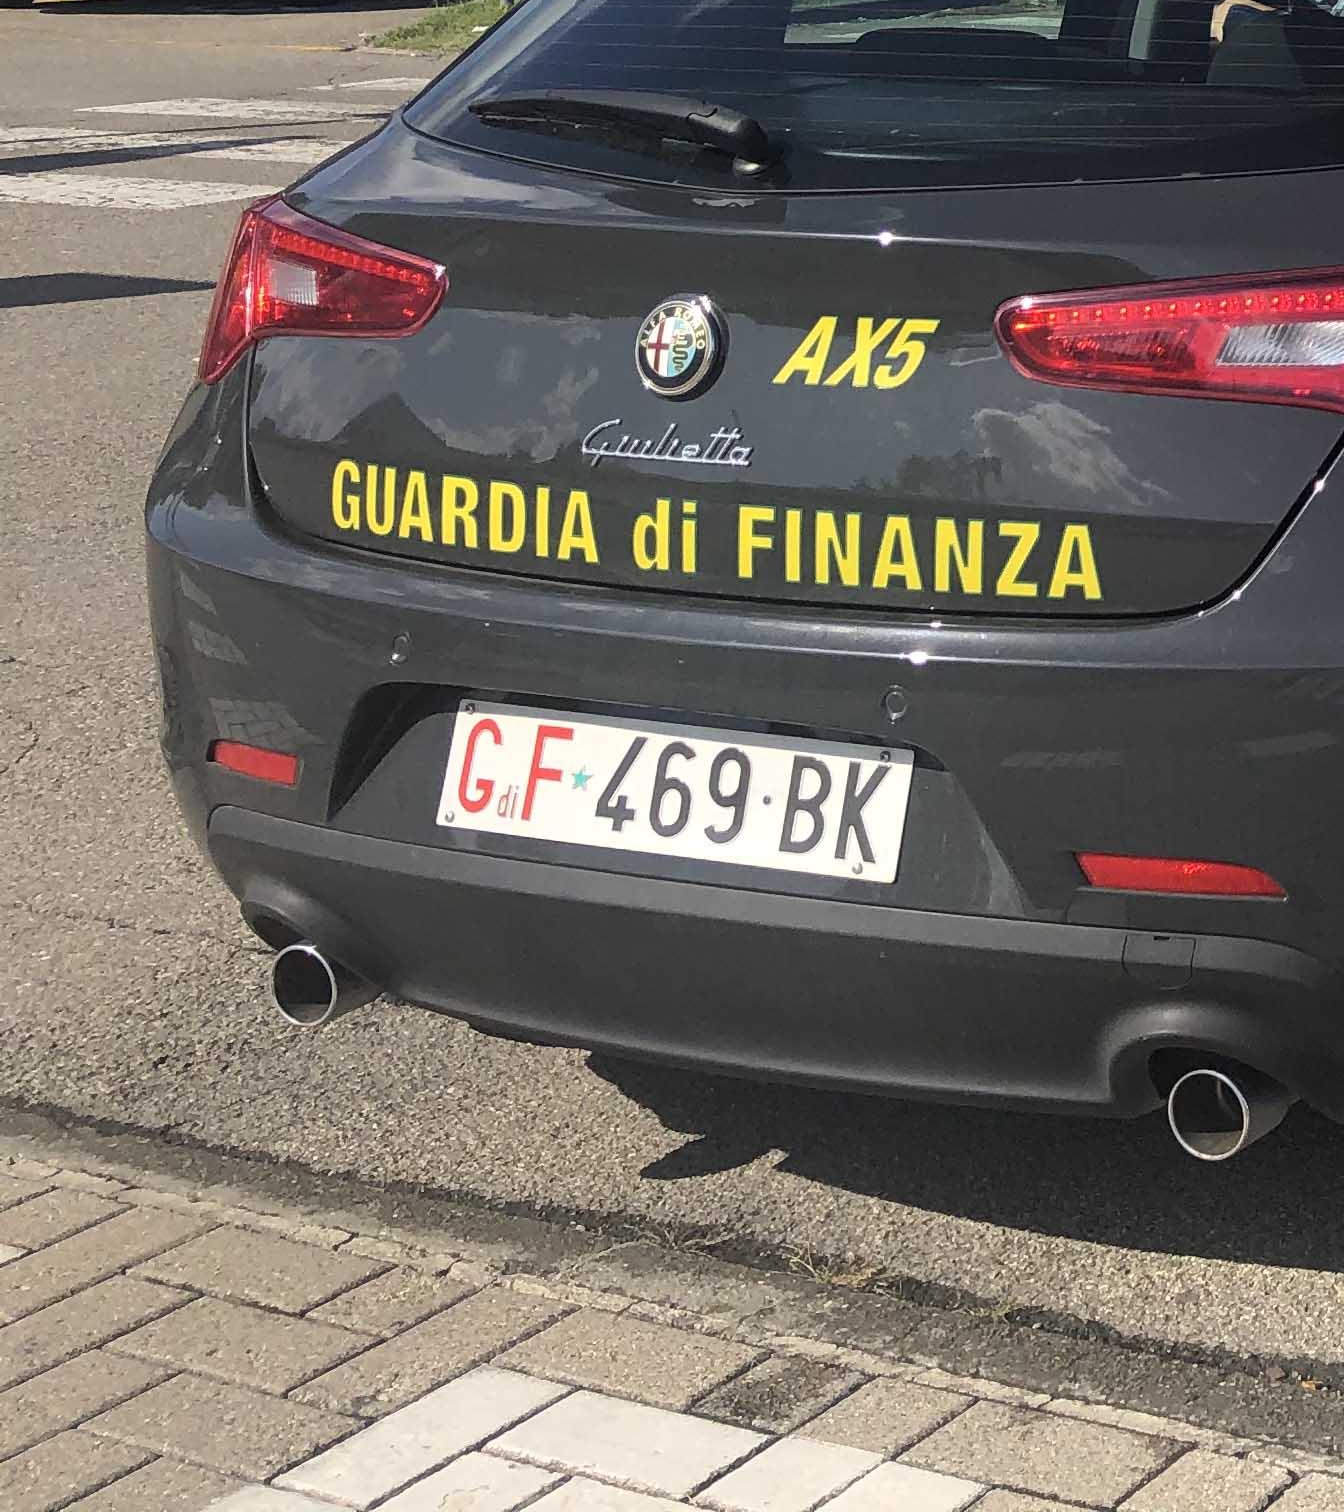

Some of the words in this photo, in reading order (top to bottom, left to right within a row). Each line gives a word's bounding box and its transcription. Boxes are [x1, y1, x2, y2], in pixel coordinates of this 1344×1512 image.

[640, 311, 667, 349] ALFA
[772, 316, 941, 390] AX5
[581, 418, 755, 467] Giulietta
[331, 459, 600, 565] GUARDIA
[632, 497, 698, 575] di
[736, 503, 1104, 602] FINANZA
